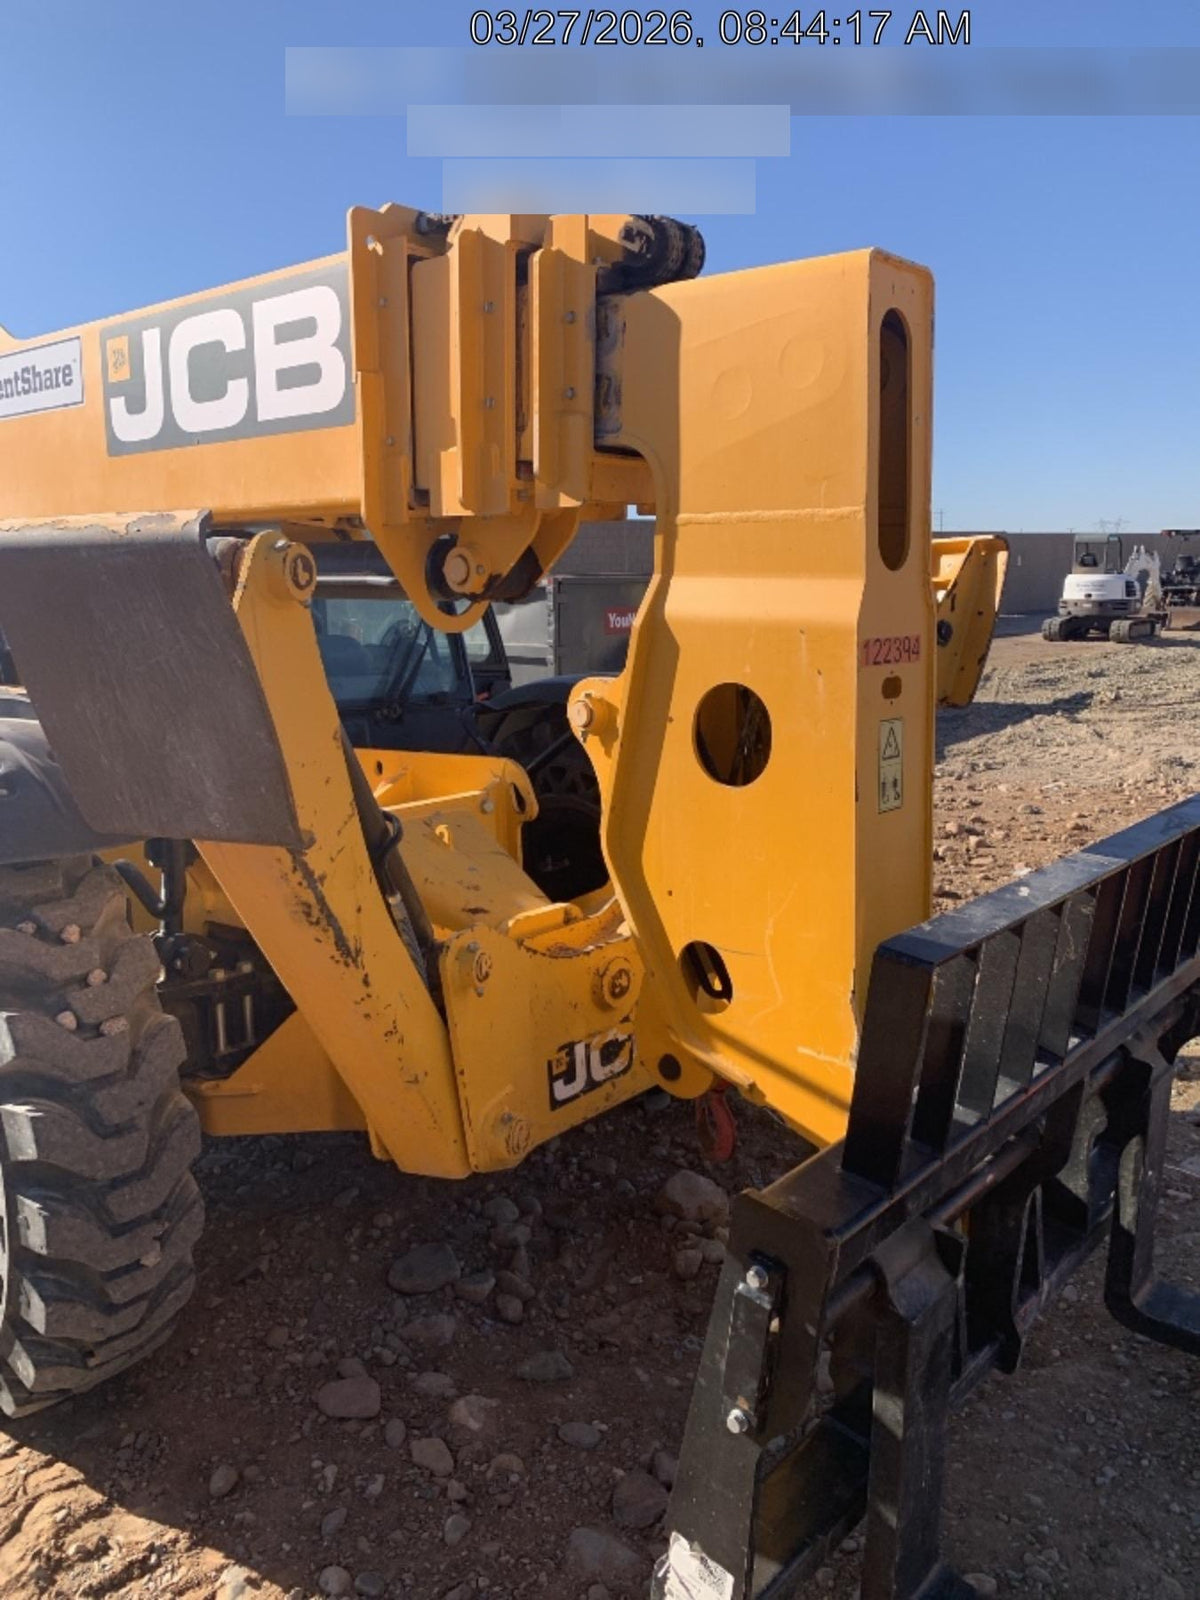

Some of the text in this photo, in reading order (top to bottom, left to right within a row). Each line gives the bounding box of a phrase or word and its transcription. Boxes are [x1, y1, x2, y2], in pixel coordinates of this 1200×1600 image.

[110, 285, 346, 442] JCB
[863, 635, 921, 667] 122394
[552, 1028, 637, 1101] JC
